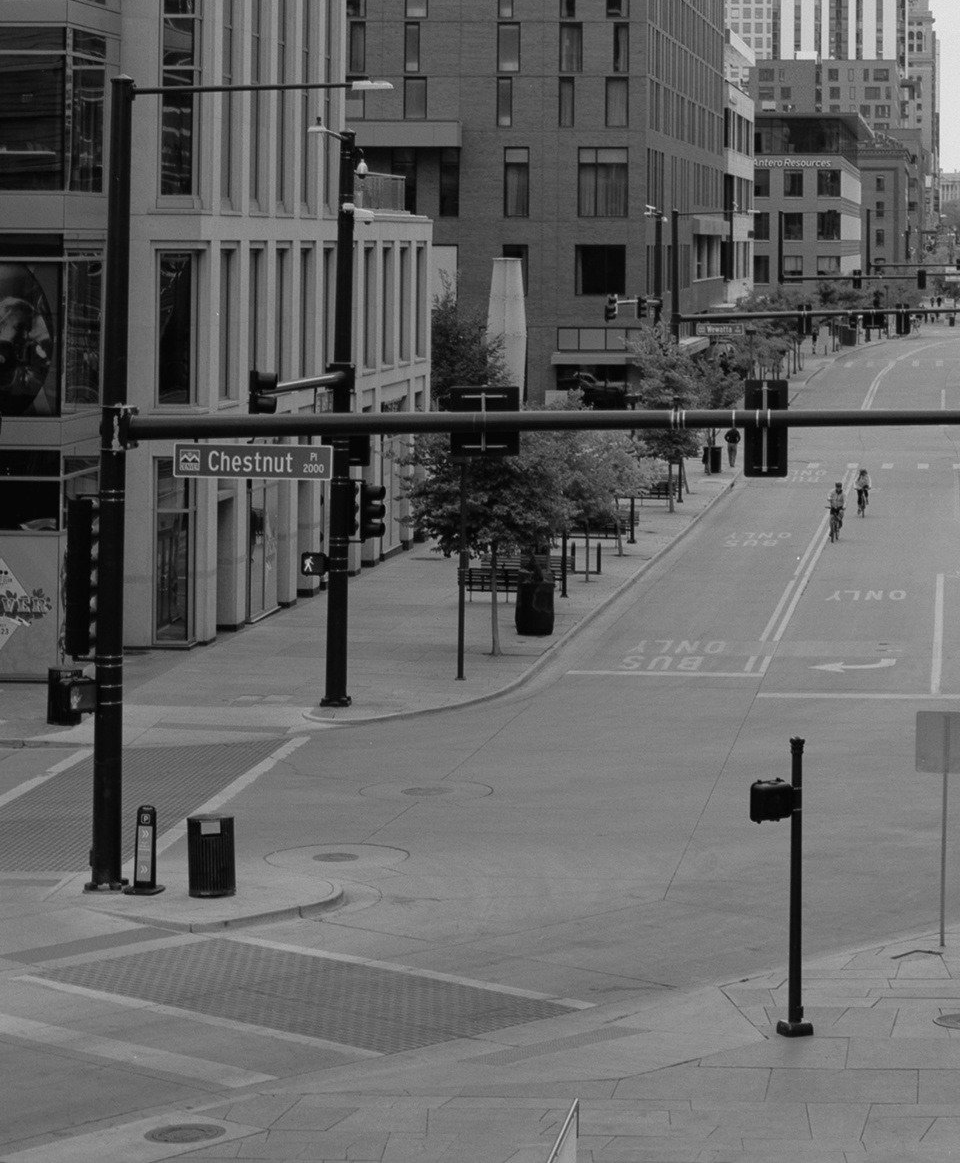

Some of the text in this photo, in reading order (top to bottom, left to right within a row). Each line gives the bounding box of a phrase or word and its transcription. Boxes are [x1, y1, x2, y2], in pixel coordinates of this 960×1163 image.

[753, 158, 832, 168] Antero Resources
[207, 450, 293, 474] Chestnut
[302, 463, 325, 474] 2000
[724, 531, 792, 539] ONLY
[723, 539, 779, 547] BUS
[824, 589, 907, 601] ONLY
[625, 639, 726, 654] ONLY
[617, 655, 705, 670] BUS
